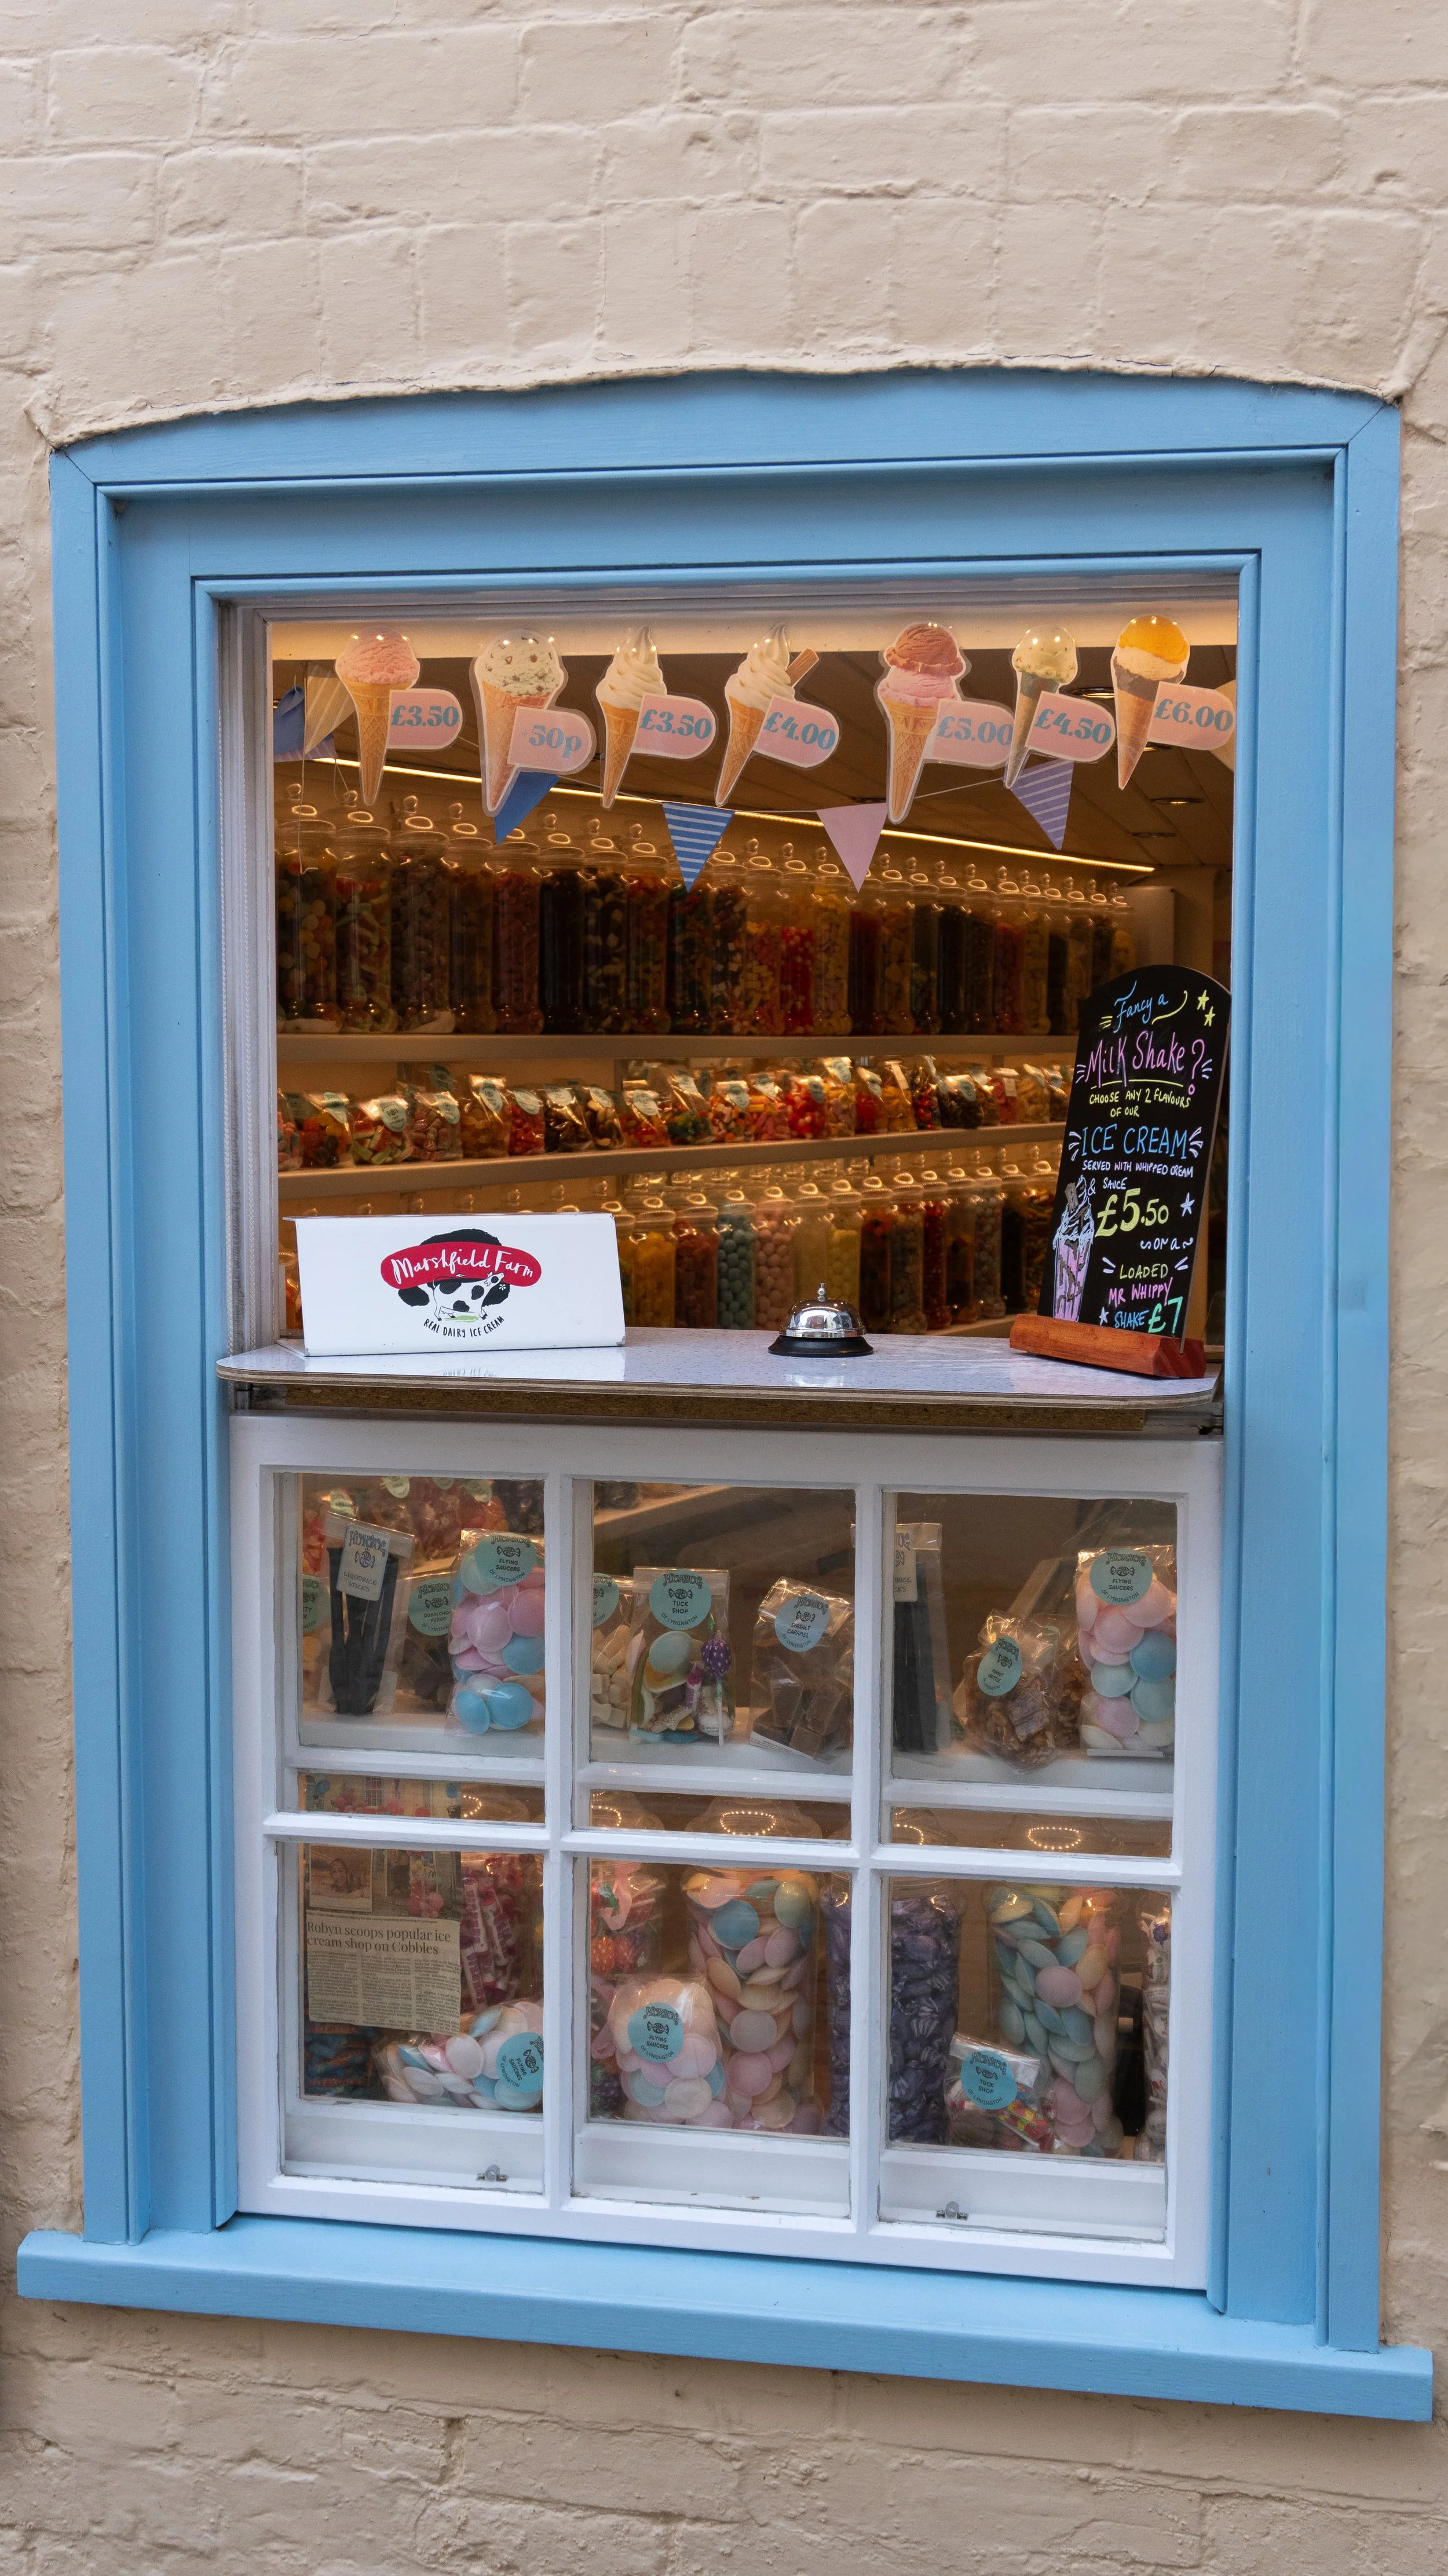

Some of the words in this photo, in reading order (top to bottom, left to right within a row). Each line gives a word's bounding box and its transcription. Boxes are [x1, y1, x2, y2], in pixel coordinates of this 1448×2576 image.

[392, 705, 459, 727] £3.50
[1154, 698, 1233, 731] £6.00
[639, 709, 712, 739] £3.50
[763, 712, 836, 749] £4.00
[937, 716, 1014, 746] £5.00
[1034, 708, 1111, 744] £4.50
[1113, 980, 1153, 1033] Fancy
[1158, 994, 1168, 1005] a
[1089, 1091, 1120, 1104] CHOOSE
[1125, 1089, 1142, 1102] ANY
[1145, 1088, 1151, 1103] 2
[1154, 1088, 1191, 1108] FLAVOURS
[1110, 1107, 1122, 1118] OF
[1125, 1106, 1140, 1117] OUR
[1081, 1124, 1117, 1156] ICE
[1123, 1126, 1187, 1159] CREAM
[1082, 1160, 1111, 1171] SERVED
[1114, 1162, 1132, 1172] WITH
[1135, 1162, 1168, 1176] WHIPPED
[1170, 1165, 1194, 1178] CREAM
[1088, 1178, 1096, 1196] &
[1103, 1177, 1128, 1190] SAUCE
[1095, 1188, 1169, 1238] £5.50
[390, 1249, 491, 1285] Marshfield
[495, 1250, 533, 1278] Farm
[1120, 1263, 1168, 1279] LOADED
[1109, 1287, 1126, 1308] MR
[1131, 1276, 1173, 1307] WHIPPY
[1114, 1310, 1150, 1329] SHAKE
[1148, 1296, 1183, 1334] £7
[423, 1319, 440, 1333] REAL
[443, 1326, 466, 1338] DAIRY
[470, 1327, 481, 1337] ICE
[483, 1315, 504, 1334] CREAM
[349, 1530, 387, 1557] HUMBUG
[1106, 1552, 1147, 1567] HUMBUG
[343, 1571, 377, 1585] LIQUORICE
[348, 1581, 370, 1592] STICKS
[495, 1572, 525, 1583] LYMINGTON
[663, 1572, 703, 1590] HUMBUG
[1107, 1591, 1139, 1602] LYMINGTON
[667, 1615, 699, 1626] LYMINGTON
[791, 1623, 810, 1631] SEASALT
[787, 1629, 809, 1638] CARAMEL
[307, 1921, 342, 1936] Robyn
[345, 1927, 383, 1938] scoops
[386, 1927, 432, 1941] popular
[435, 1929, 451, 1942] ice
[307, 1937, 342, 1948] cream
[345, 1938, 372, 1952] shop
[375, 1942, 390, 1952] on
[392, 1941, 438, 1955] Cobbles
[643, 2006, 680, 2026] HUMBUG
[646, 2041, 669, 2050] SAUCERS
[649, 2035, 667, 2043] FLYING
[646, 2051, 674, 2060] LYMINGTON
[500, 2063, 520, 2088] LYMINGTON
[509, 2058, 522, 2081] SAUCERS
[515, 2058, 527, 2076] FLYING
[978, 2086, 994, 2094] SHOP
[979, 2079, 994, 2088] TUCK
[973, 2095, 1003, 2106] LYMINGTON
